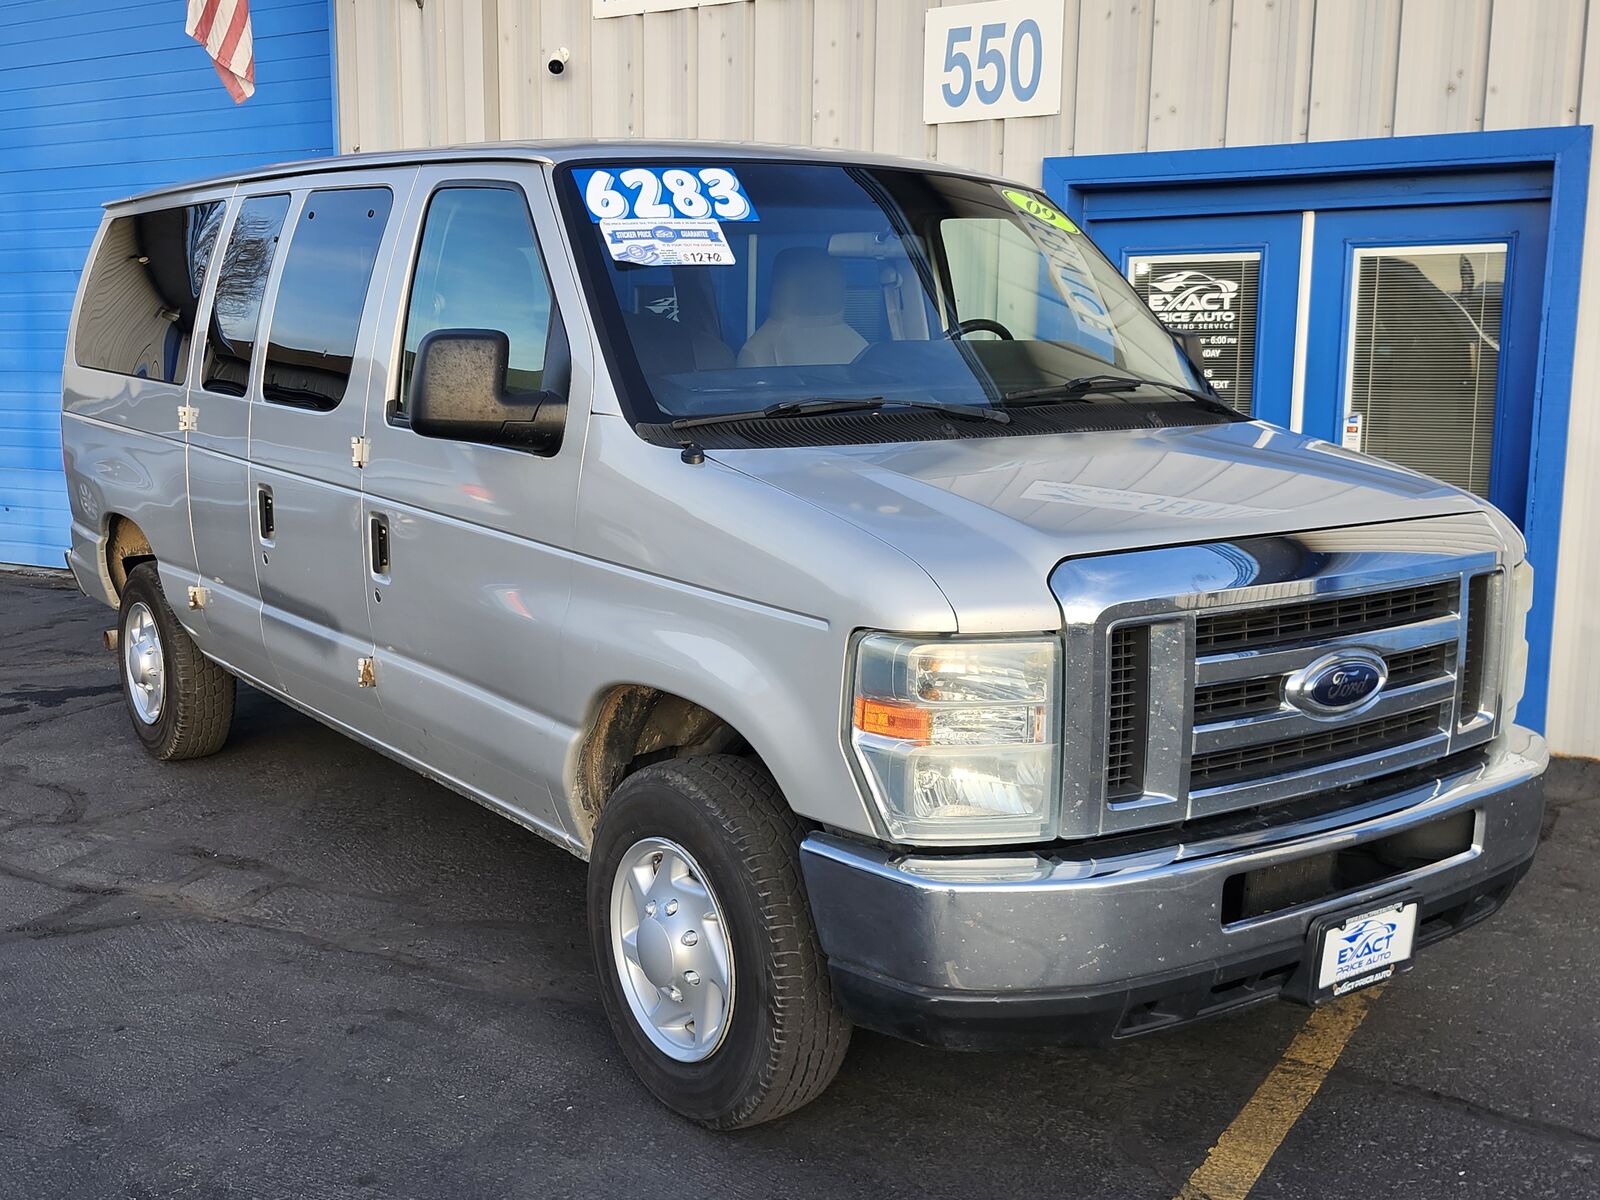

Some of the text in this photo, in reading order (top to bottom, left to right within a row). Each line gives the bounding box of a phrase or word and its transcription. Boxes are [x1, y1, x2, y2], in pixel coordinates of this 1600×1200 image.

[942, 19, 1042, 107] 550
[586, 168, 751, 219] 6283
[1026, 200, 1056, 221] 09
[637, 230, 652, 238] PRICE
[1149, 292, 1238, 311] EXACT
[1157, 312, 1235, 322] RICE AUTO
[1211, 336, 1226, 344] 6:00
[1328, 671, 1369, 699] Ford
[1337, 933, 1395, 965] EXACT
[1336, 960, 1363, 975] PRICE
[1366, 951, 1391, 966] AUTO
